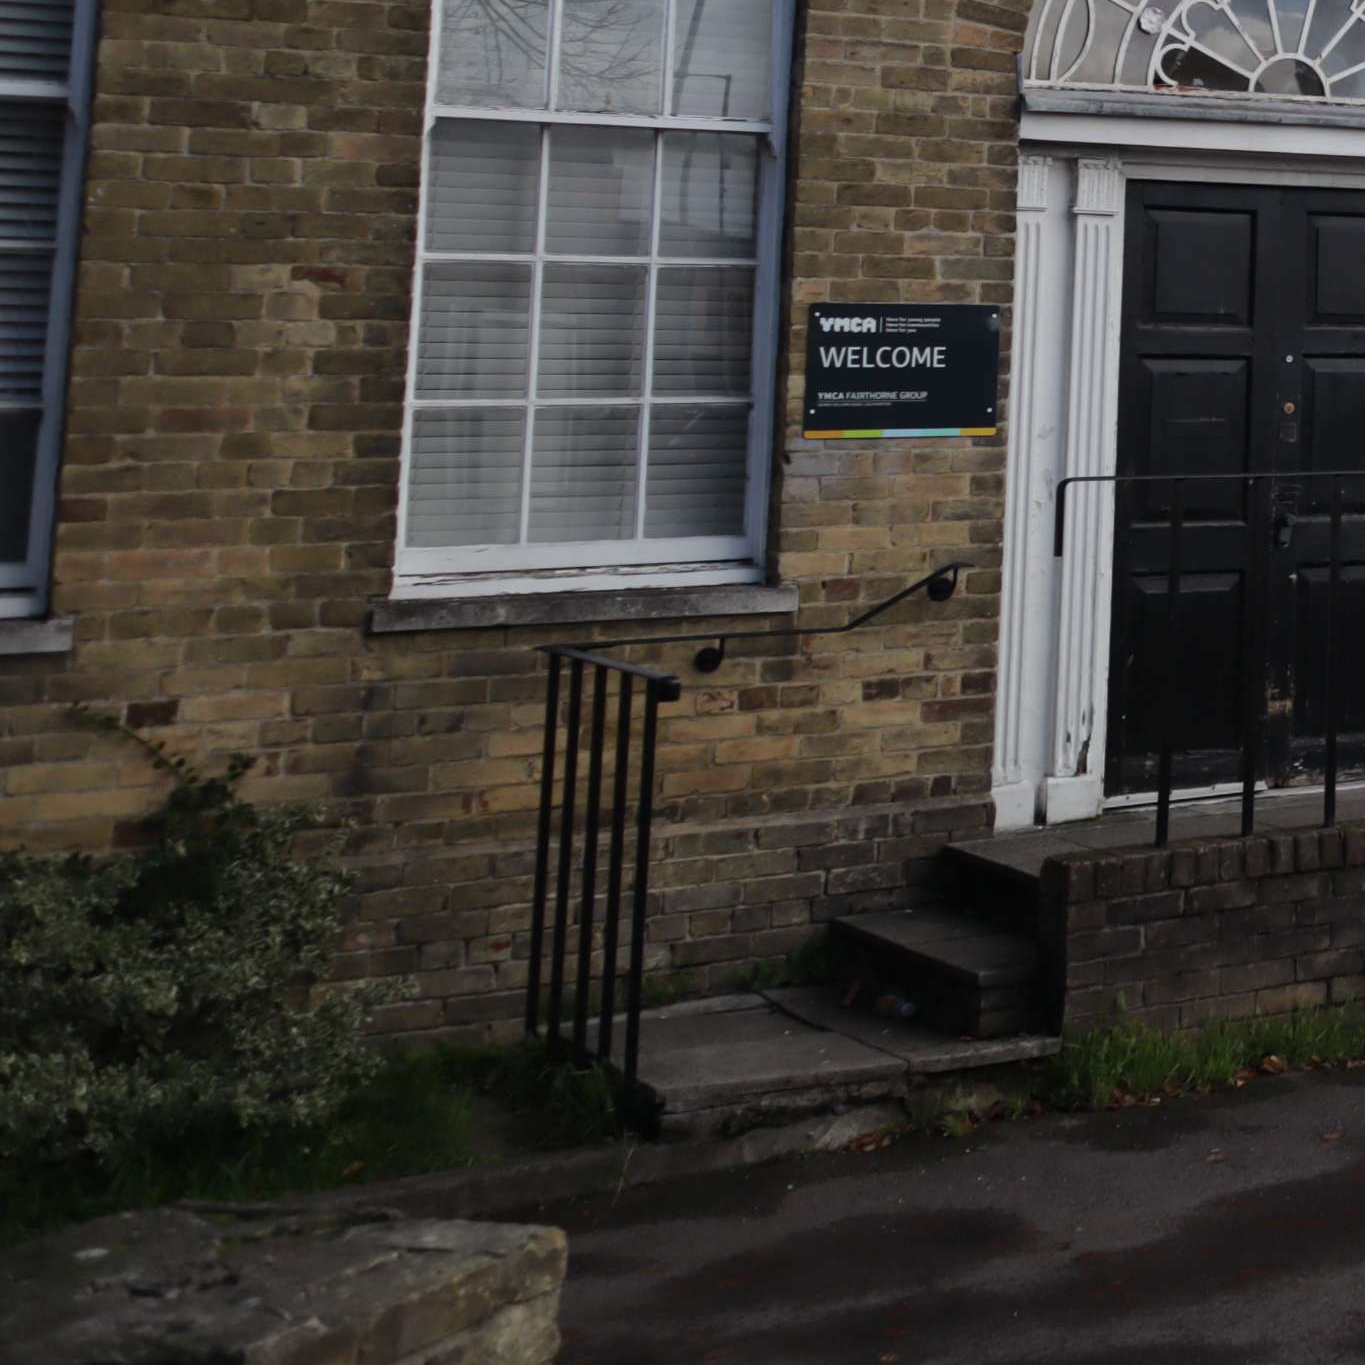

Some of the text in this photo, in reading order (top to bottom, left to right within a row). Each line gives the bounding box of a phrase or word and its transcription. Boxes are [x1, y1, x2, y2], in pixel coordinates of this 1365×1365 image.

[820, 317, 877, 333] YMCA
[819, 346, 947, 368] WELCOME
[818, 391, 928, 400] YMCA FAIRTHORNE GROUP
